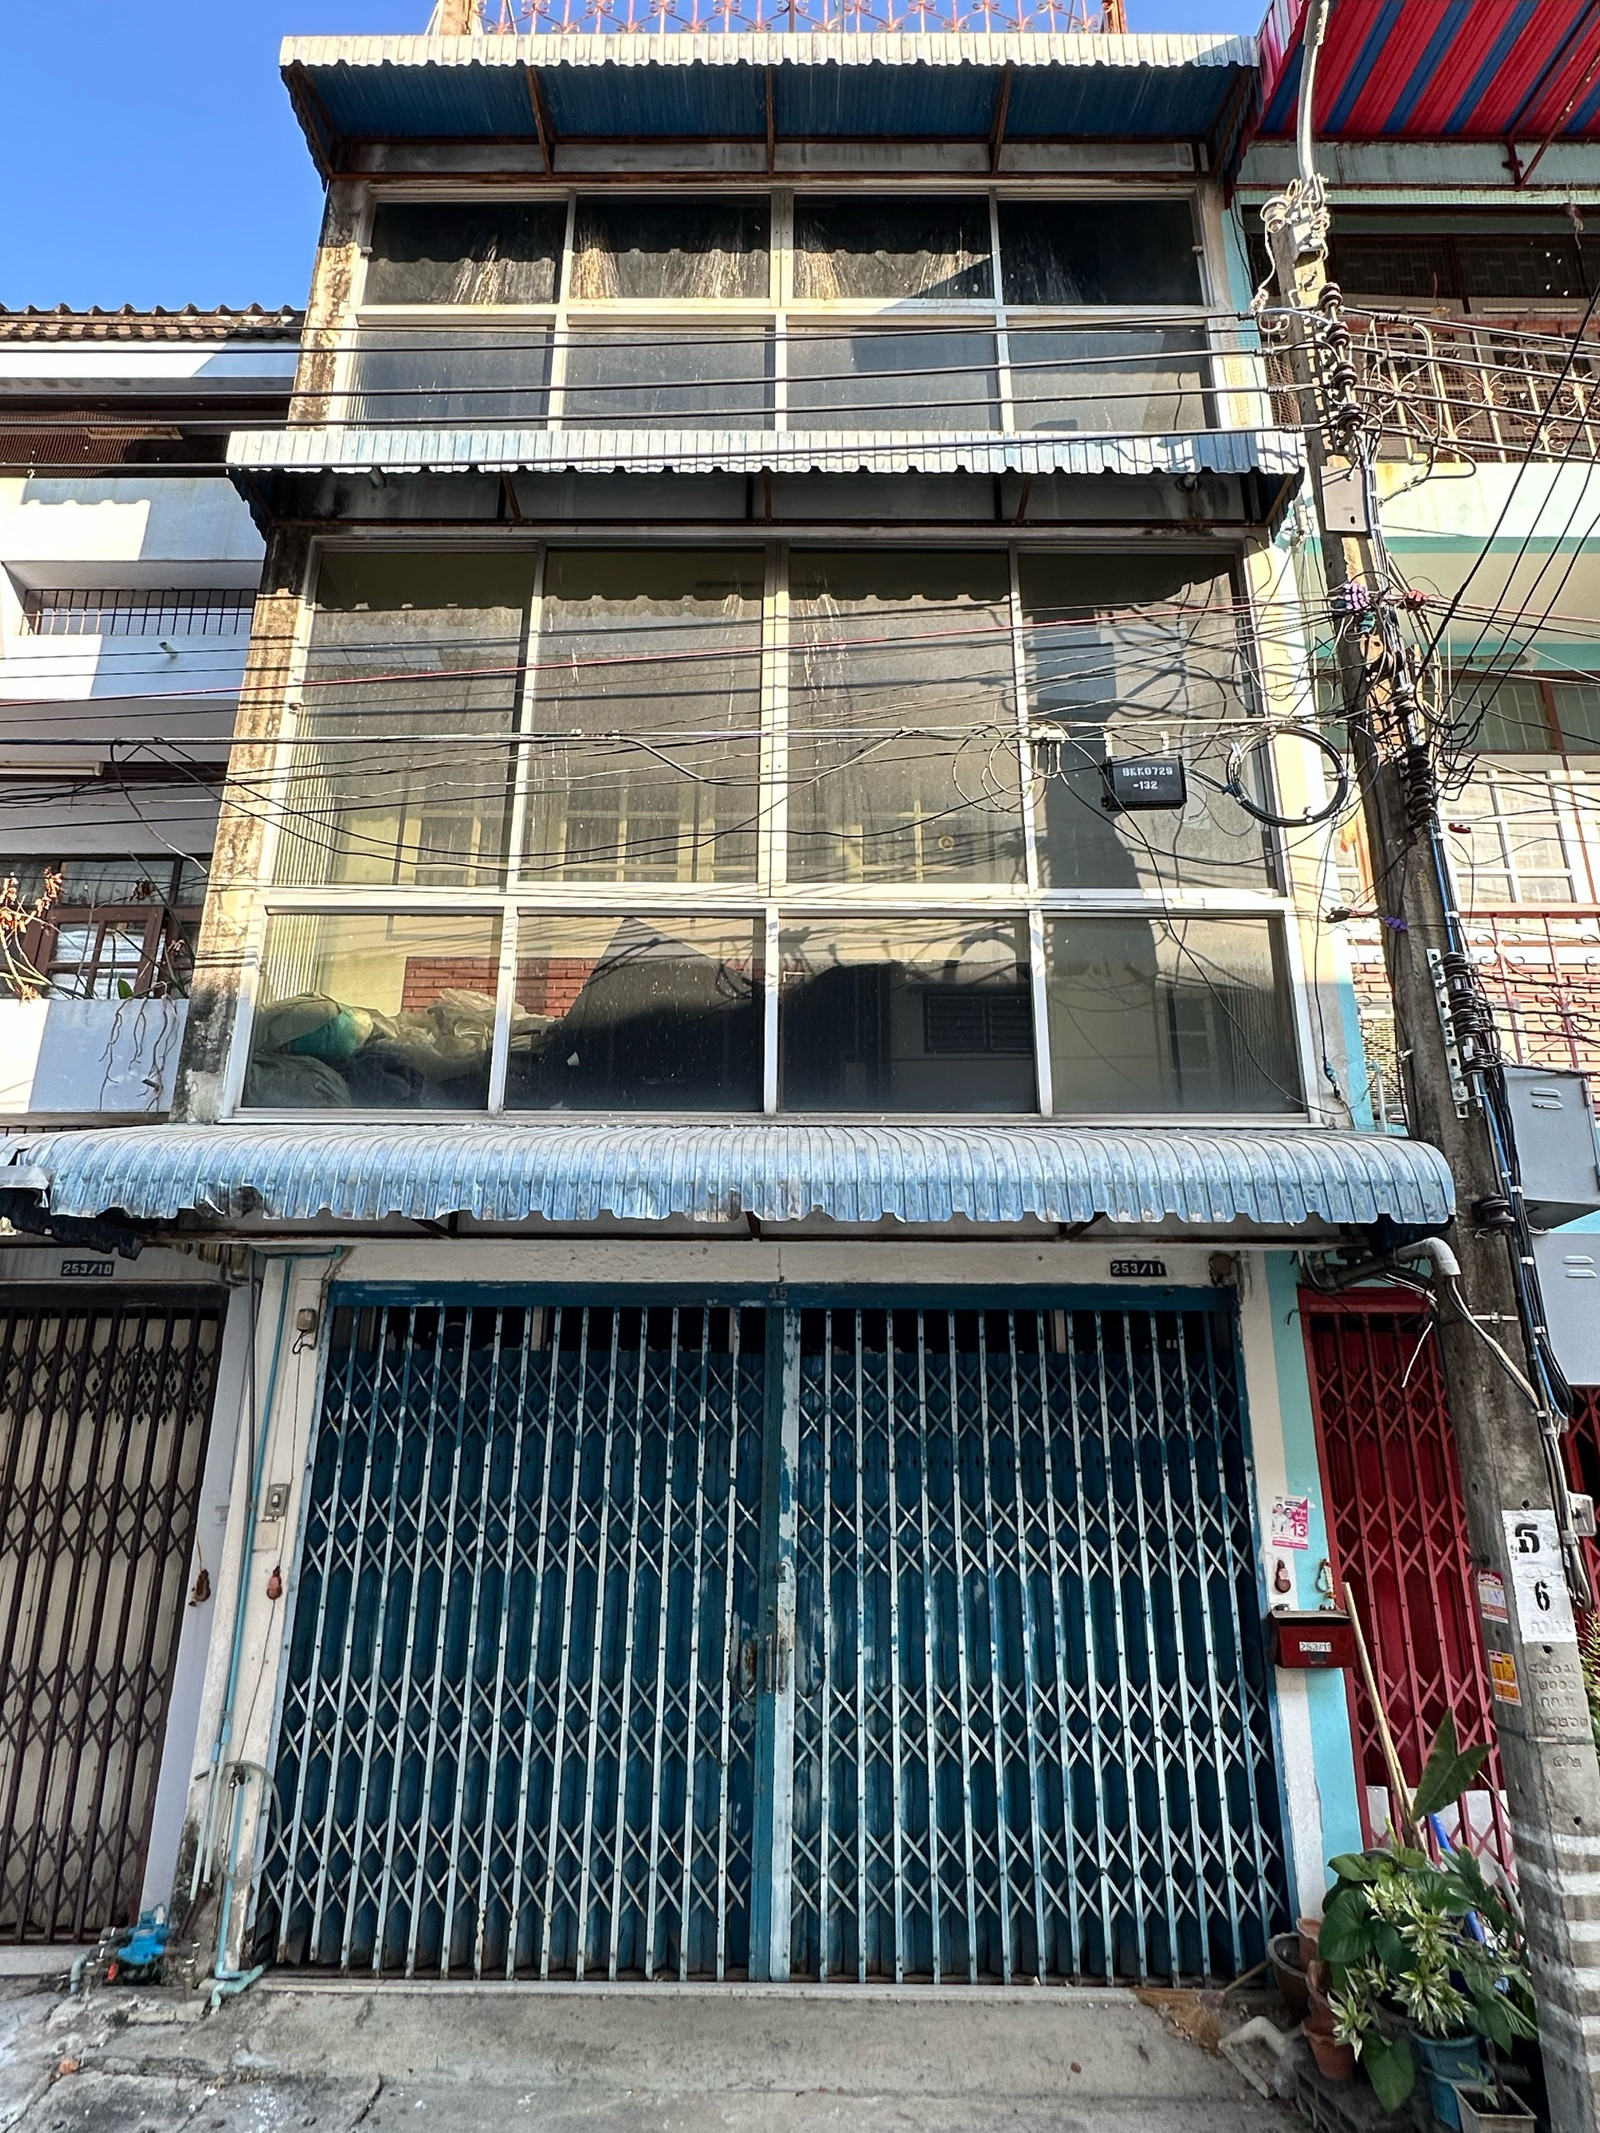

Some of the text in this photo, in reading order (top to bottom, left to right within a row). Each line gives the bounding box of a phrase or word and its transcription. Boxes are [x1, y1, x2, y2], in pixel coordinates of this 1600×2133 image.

[1133, 781, 1158, 790] -132
[63, 1263, 113, 1274] 253/10
[1112, 1263, 1162, 1274] 253/11
[1290, 1523, 1306, 1537] 13
[1535, 1580, 1550, 1611] 6
[1300, 1643, 1331, 1652] 253/11
